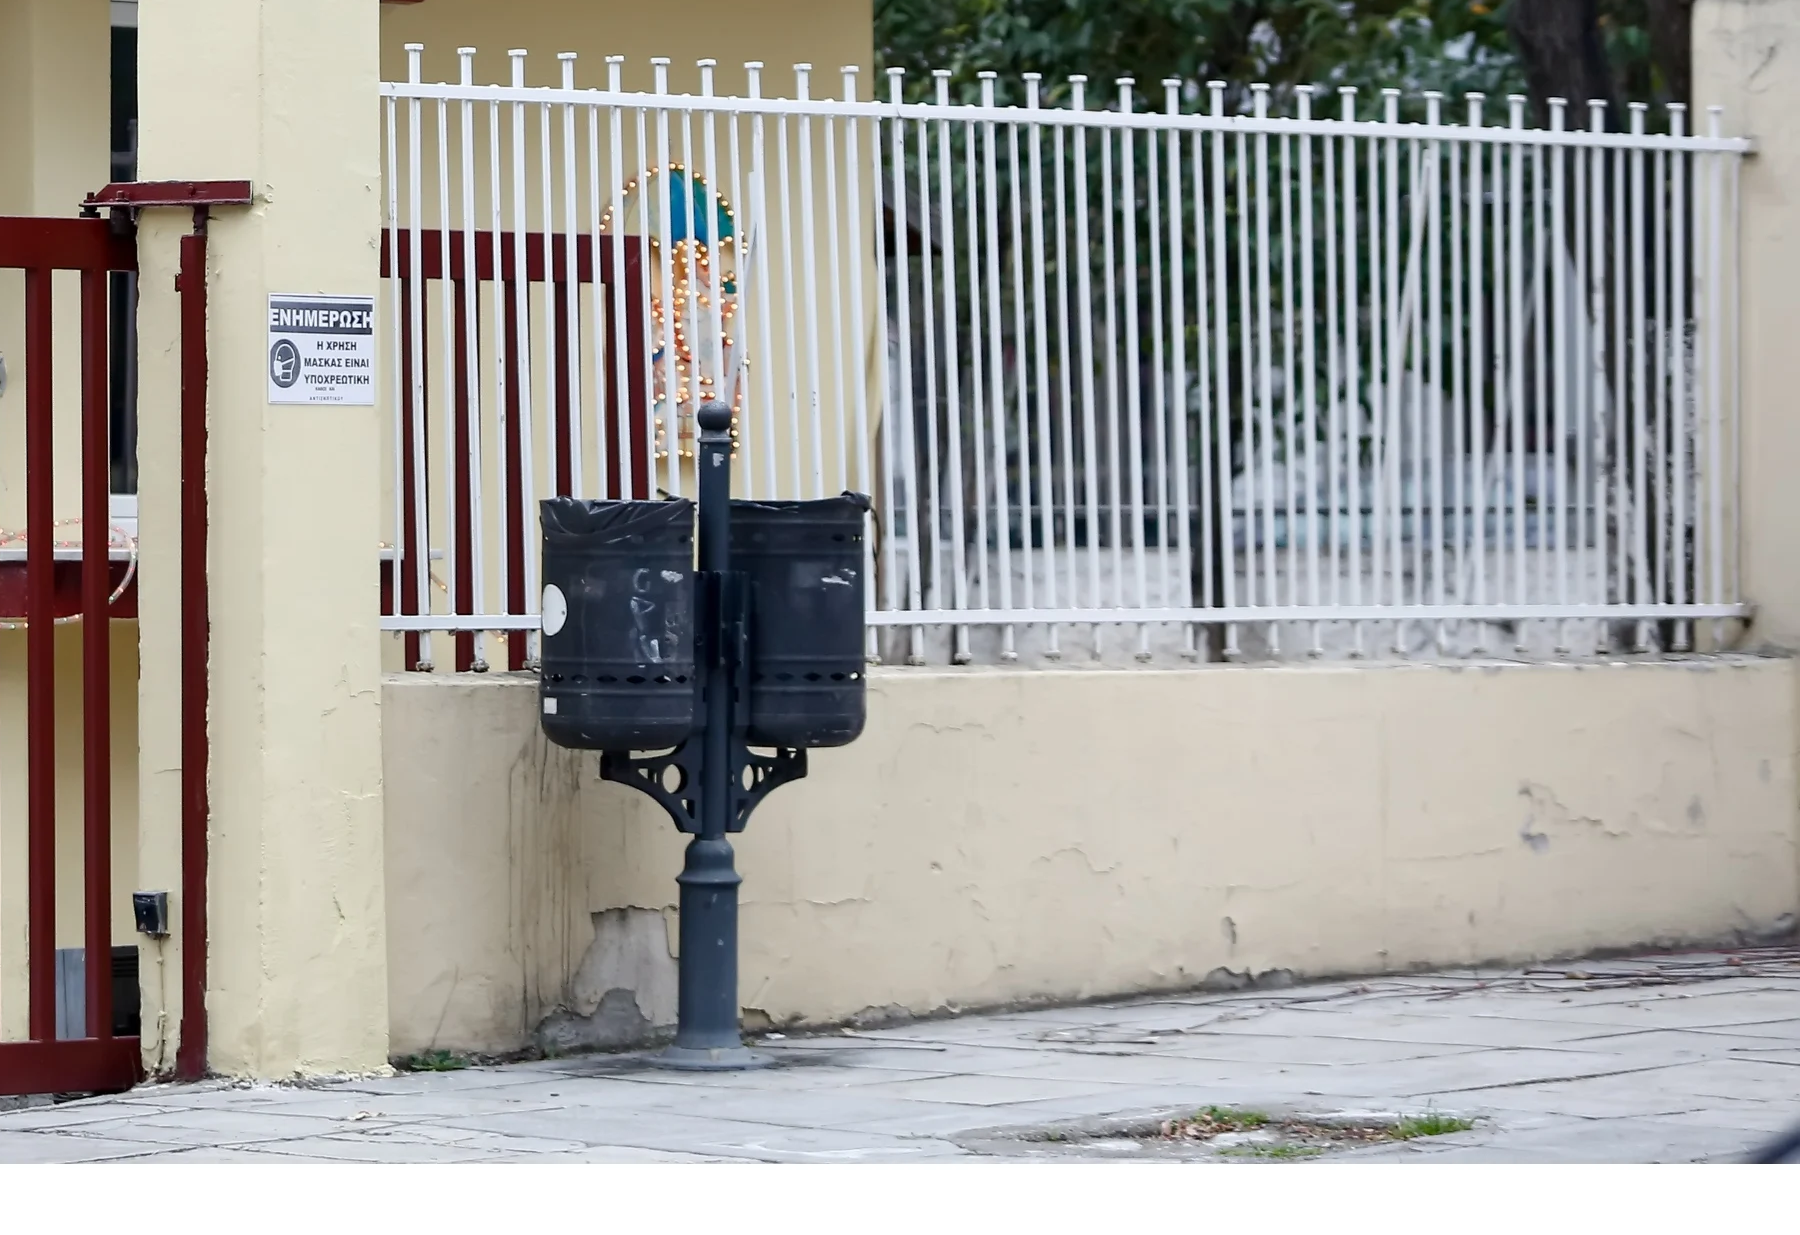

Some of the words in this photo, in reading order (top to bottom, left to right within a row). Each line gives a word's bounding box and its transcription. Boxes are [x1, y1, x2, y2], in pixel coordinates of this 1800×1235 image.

[270, 308, 373, 328] ΕΝΗΜΕΡΩΣΗ
[317, 341, 323, 350] Η
[326, 341, 357, 351] ΧΡΗΣΗ
[304, 357, 343, 367] ΜΑΣΚΑΣ
[345, 358, 369, 368] ΕΙΝΑΙ
[304, 374, 370, 384] ΥΠΟΧΡΕΩΤΙΚΗ
